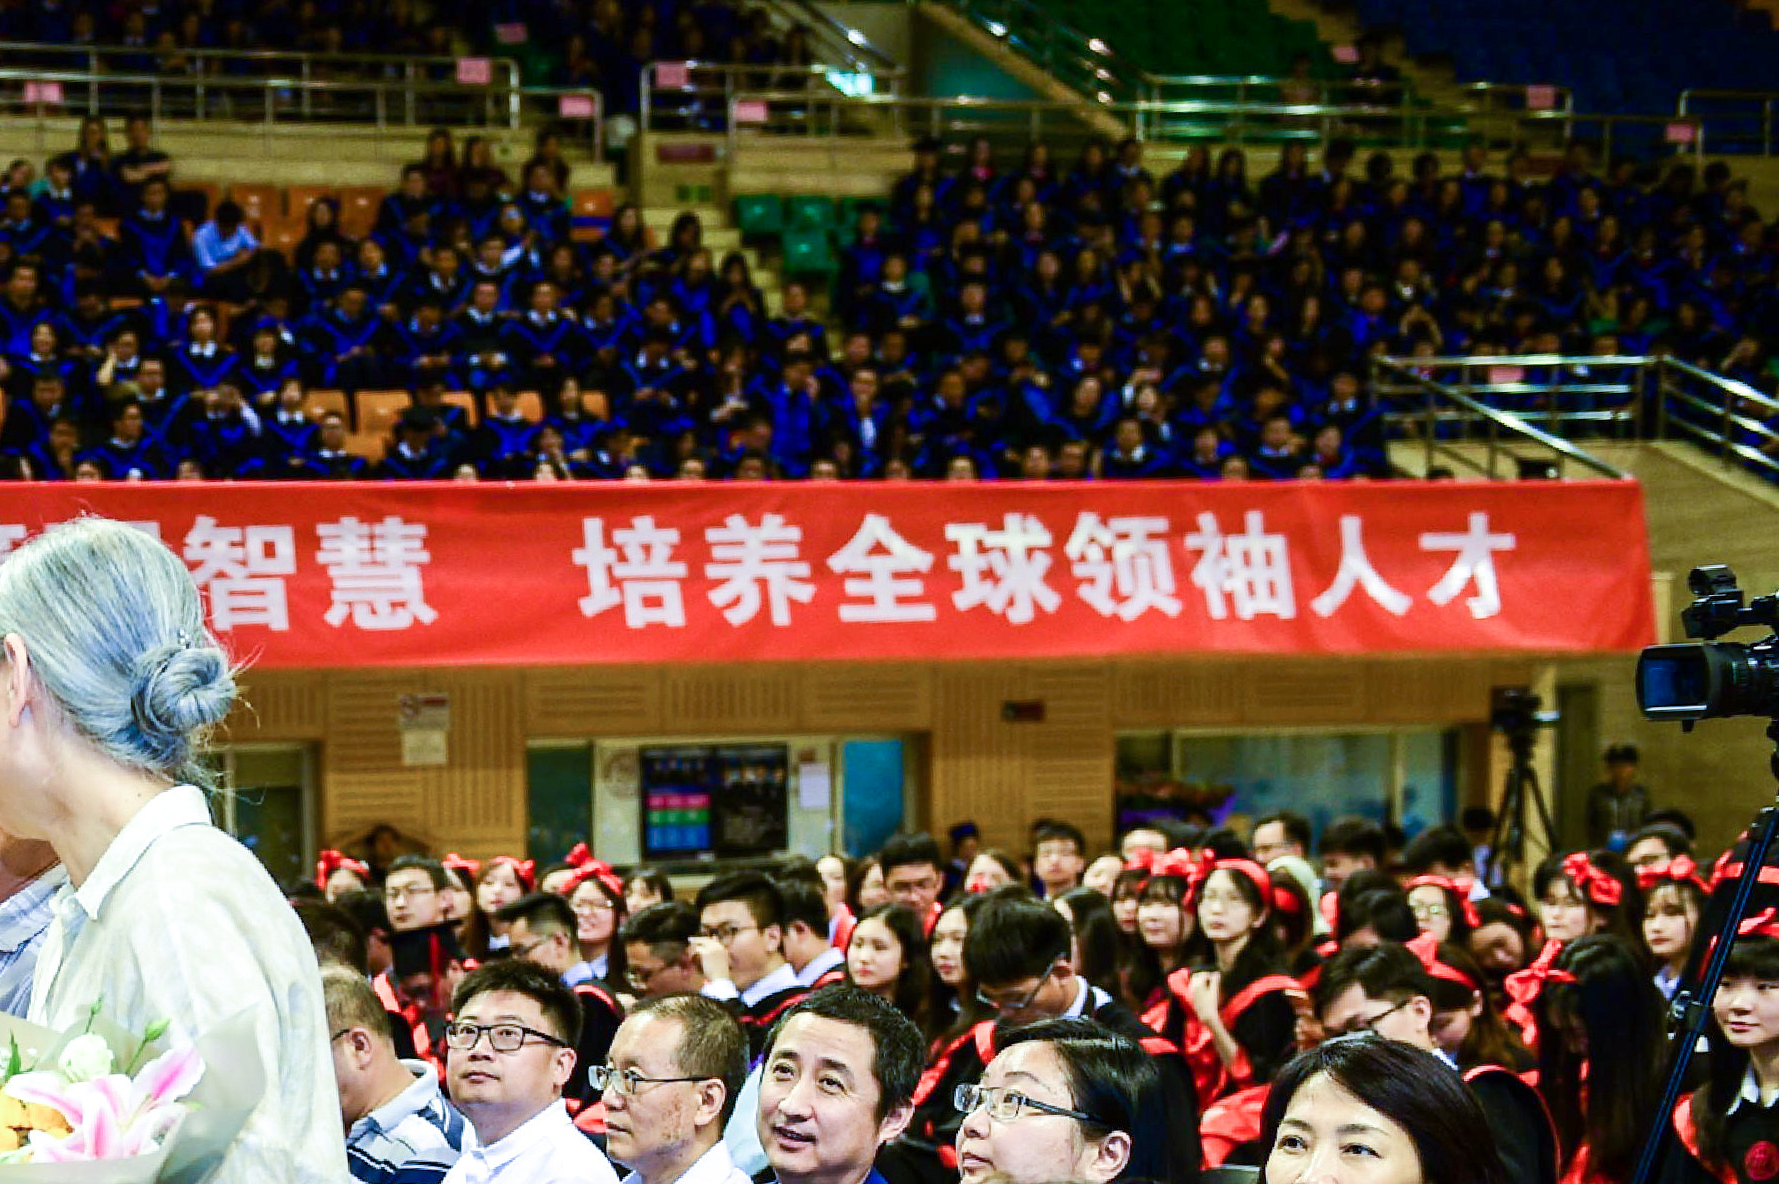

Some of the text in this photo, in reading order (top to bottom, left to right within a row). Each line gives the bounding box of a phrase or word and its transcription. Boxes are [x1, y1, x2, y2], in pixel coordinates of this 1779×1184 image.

[573, 510, 1516, 628] 培养全球领袖人才
